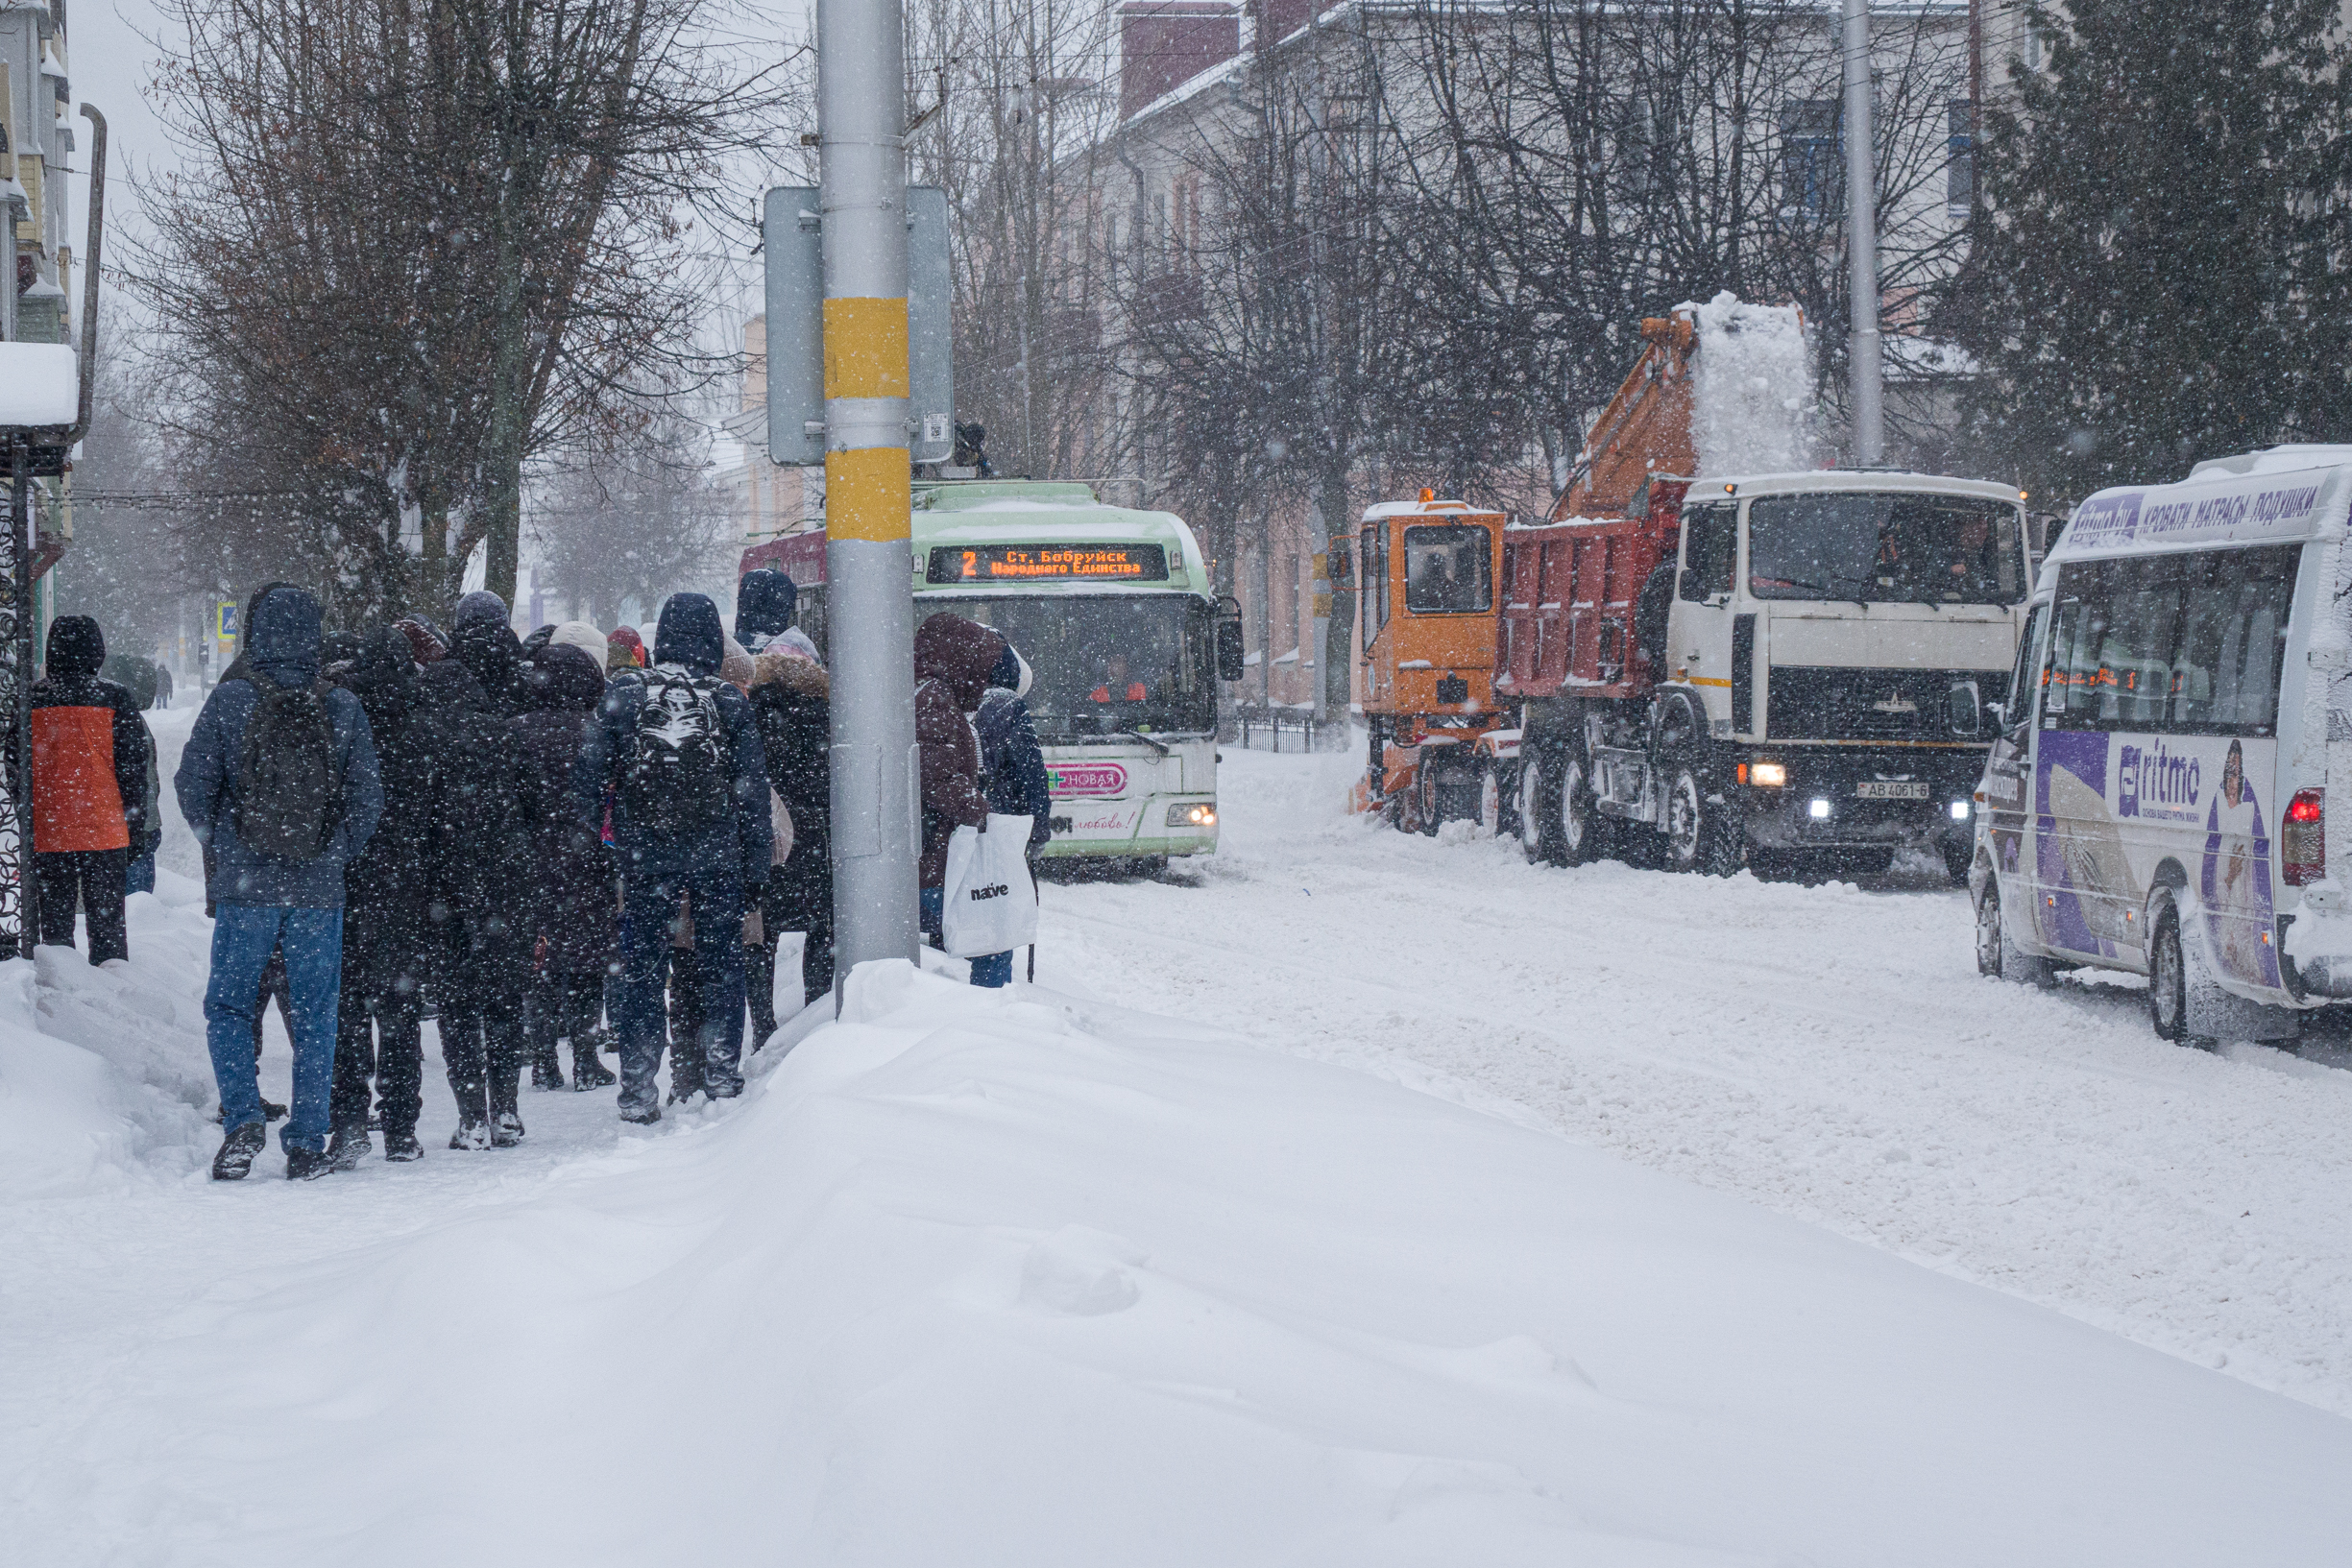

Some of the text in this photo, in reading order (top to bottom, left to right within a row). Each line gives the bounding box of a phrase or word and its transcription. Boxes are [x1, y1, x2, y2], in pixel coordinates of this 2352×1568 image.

[2140, 485, 2318, 534] КРОВАТИ МАТРАСЫ ПОДУШКИ
[962, 551, 976, 576] 2
[1006, 550, 1127, 564] Ст. Бобруйск
[991, 561, 1141, 575] Народного Единства
[2142, 737, 2199, 807] ritmo
[1068, 774, 1115, 785] НОВАЯ
[1869, 784, 1928, 796] AB 4061-6
